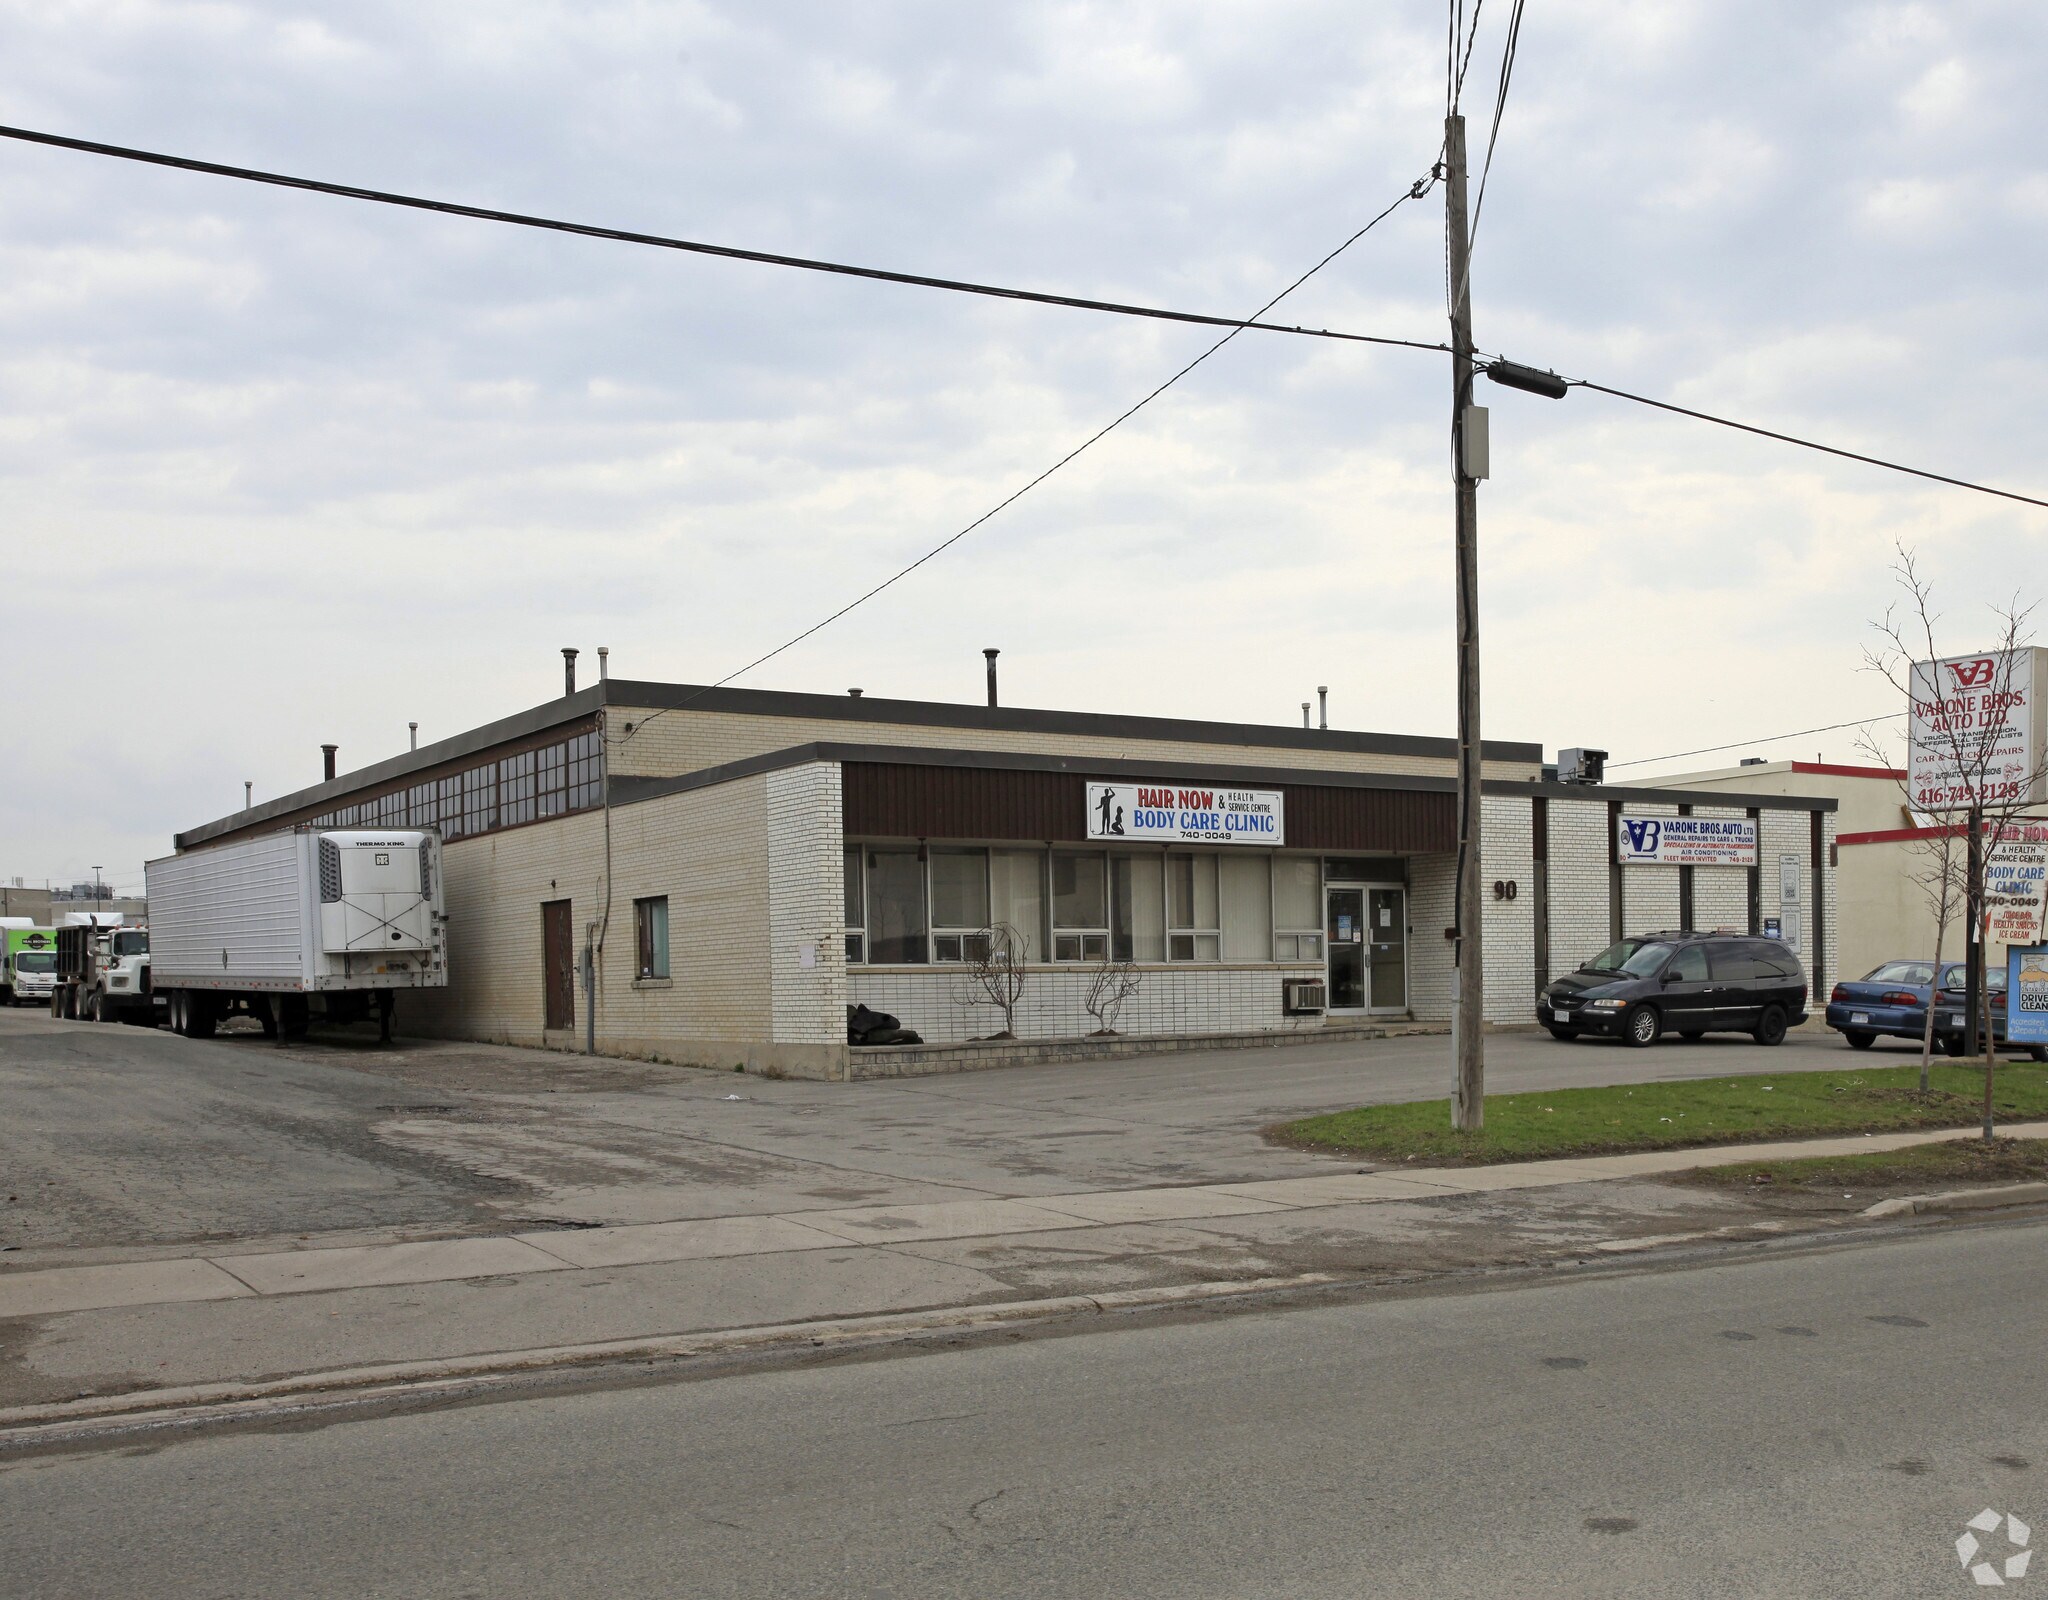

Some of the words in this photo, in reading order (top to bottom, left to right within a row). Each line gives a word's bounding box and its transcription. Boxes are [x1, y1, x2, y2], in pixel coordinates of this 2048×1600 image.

[1981, 690, 2026, 711] BROS.
[1931, 714, 1973, 732] AUTO
[1915, 755, 1935, 763] CAR
[1228, 792, 1254, 802] HEALTH
[1917, 782, 2019, 805] 416-749-2128
[1137, 788, 1174, 809] HAIR
[1178, 790, 1214, 810] NOW
[1218, 795, 1226, 810] &
[1228, 803, 1250, 812] SERVICE
[1251, 804, 1271, 813] CENTRE
[1134, 810, 1175, 829] BODY
[1180, 812, 1220, 831] CARE
[1224, 814, 1274, 833] CLINIC
[1663, 821, 1698, 834] VARONE
[1700, 823, 1722, 835] BROS.
[1722, 823, 1743, 835] AUTO
[1744, 828, 1754, 836] LTD
[1180, 831, 1232, 840] 740-0049
[1663, 834, 1687, 842] GENERAL
[2008, 846, 2036, 854] HEALTH
[1990, 854, 2018, 862] SERVICE
[2019, 855, 2046, 863] CENTRE
[1987, 866, 2016, 879] BODY
[2017, 867, 2045, 880] CARE
[1494, 880, 1517, 899] 90
[1995, 881, 2033, 894] CLINIC
[1993, 920, 2014, 929] HEALTH
[2015, 921, 2038, 930] SNACKS
[1999, 930, 2008, 938] ICE
[2010, 930, 2030, 939] CREAM
[2021, 993, 2048, 1002] DRIVE
[2021, 1002, 2048, 1010] CLEAN
